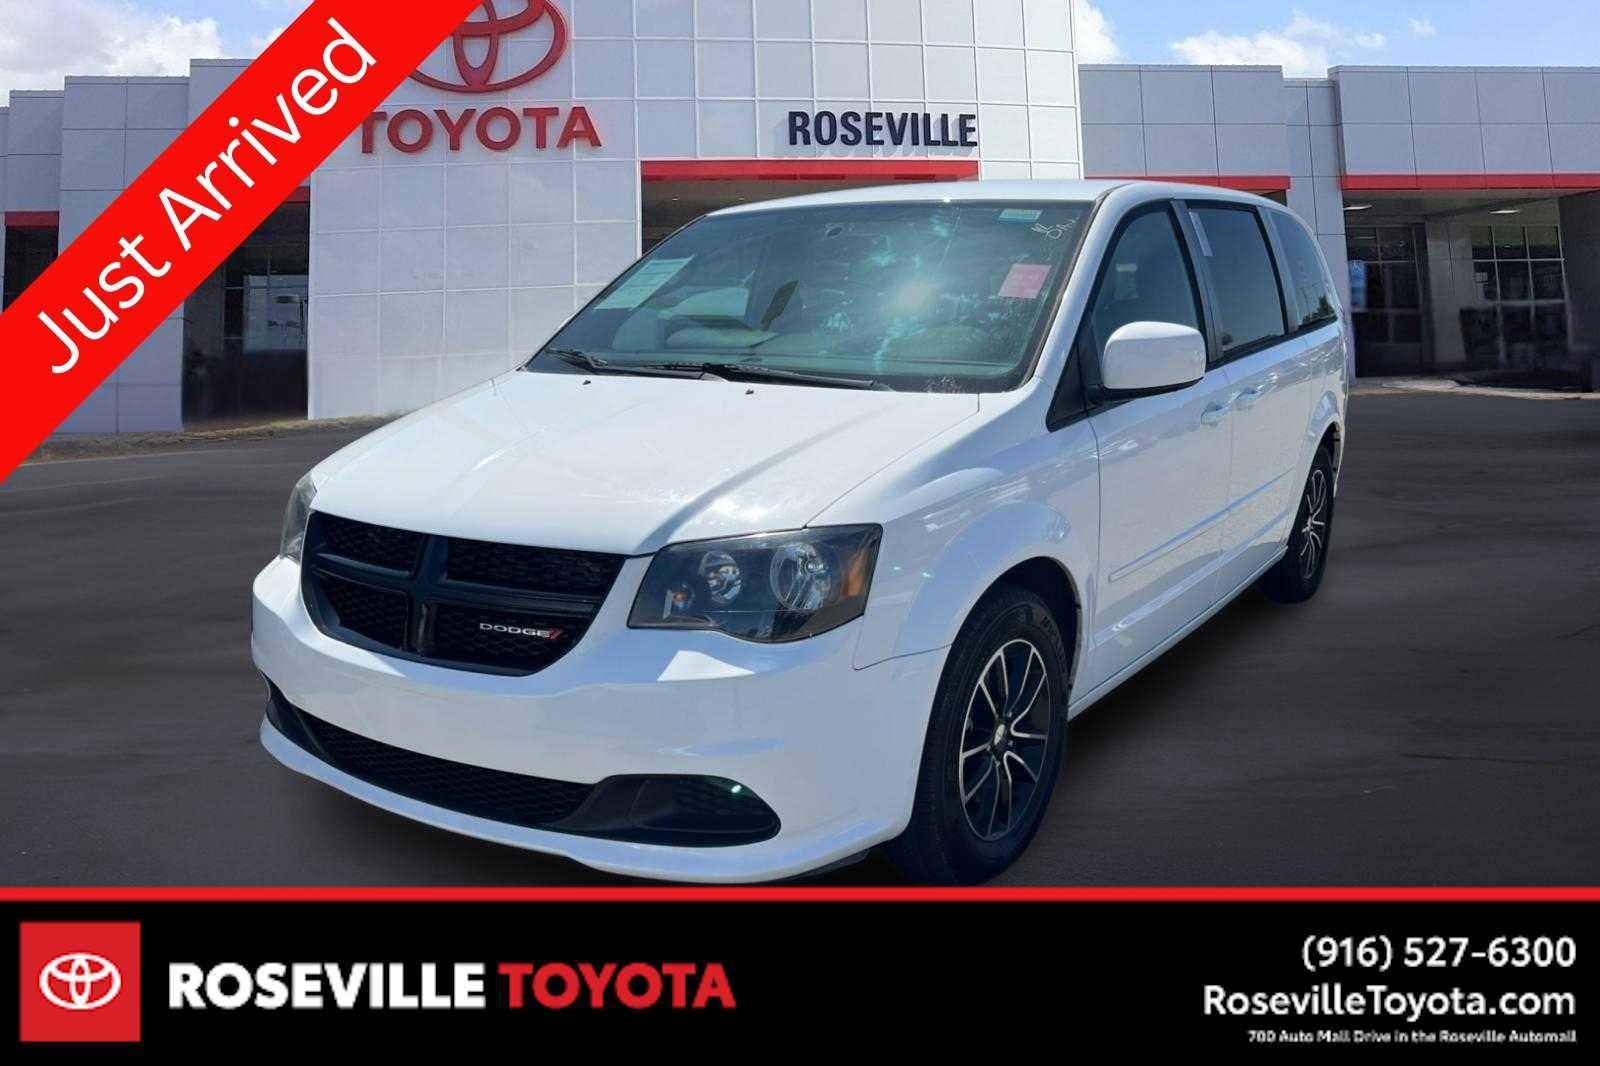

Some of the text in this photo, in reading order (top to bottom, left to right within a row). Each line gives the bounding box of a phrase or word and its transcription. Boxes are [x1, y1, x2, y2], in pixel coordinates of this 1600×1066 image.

[361, 106, 602, 154] TOYOTA
[788, 111, 978, 147] ROSEVILLE
[479, 622, 551, 638] DODGE
